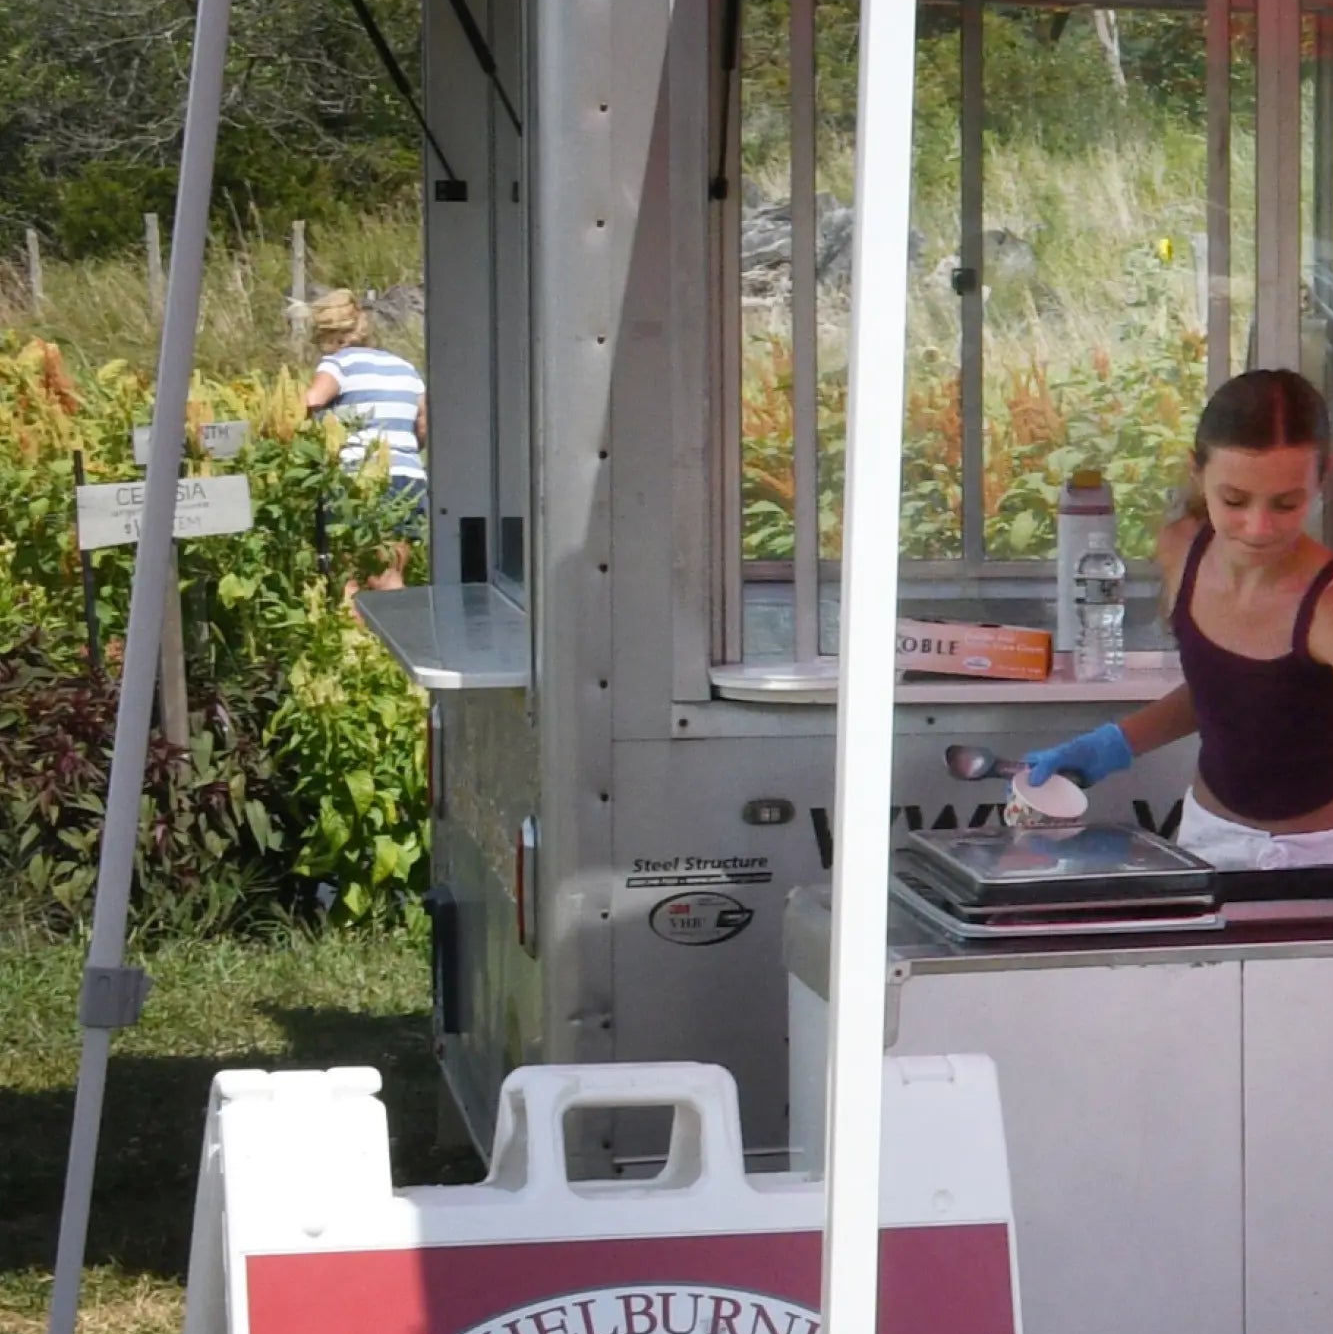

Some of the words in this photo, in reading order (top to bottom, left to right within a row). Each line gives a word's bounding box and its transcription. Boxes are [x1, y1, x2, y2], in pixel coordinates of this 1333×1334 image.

[116, 482, 207, 506] CESIA
[897, 635, 960, 656] OBLE
[632, 856, 680, 873] Steel
[685, 855, 768, 872] Structure
